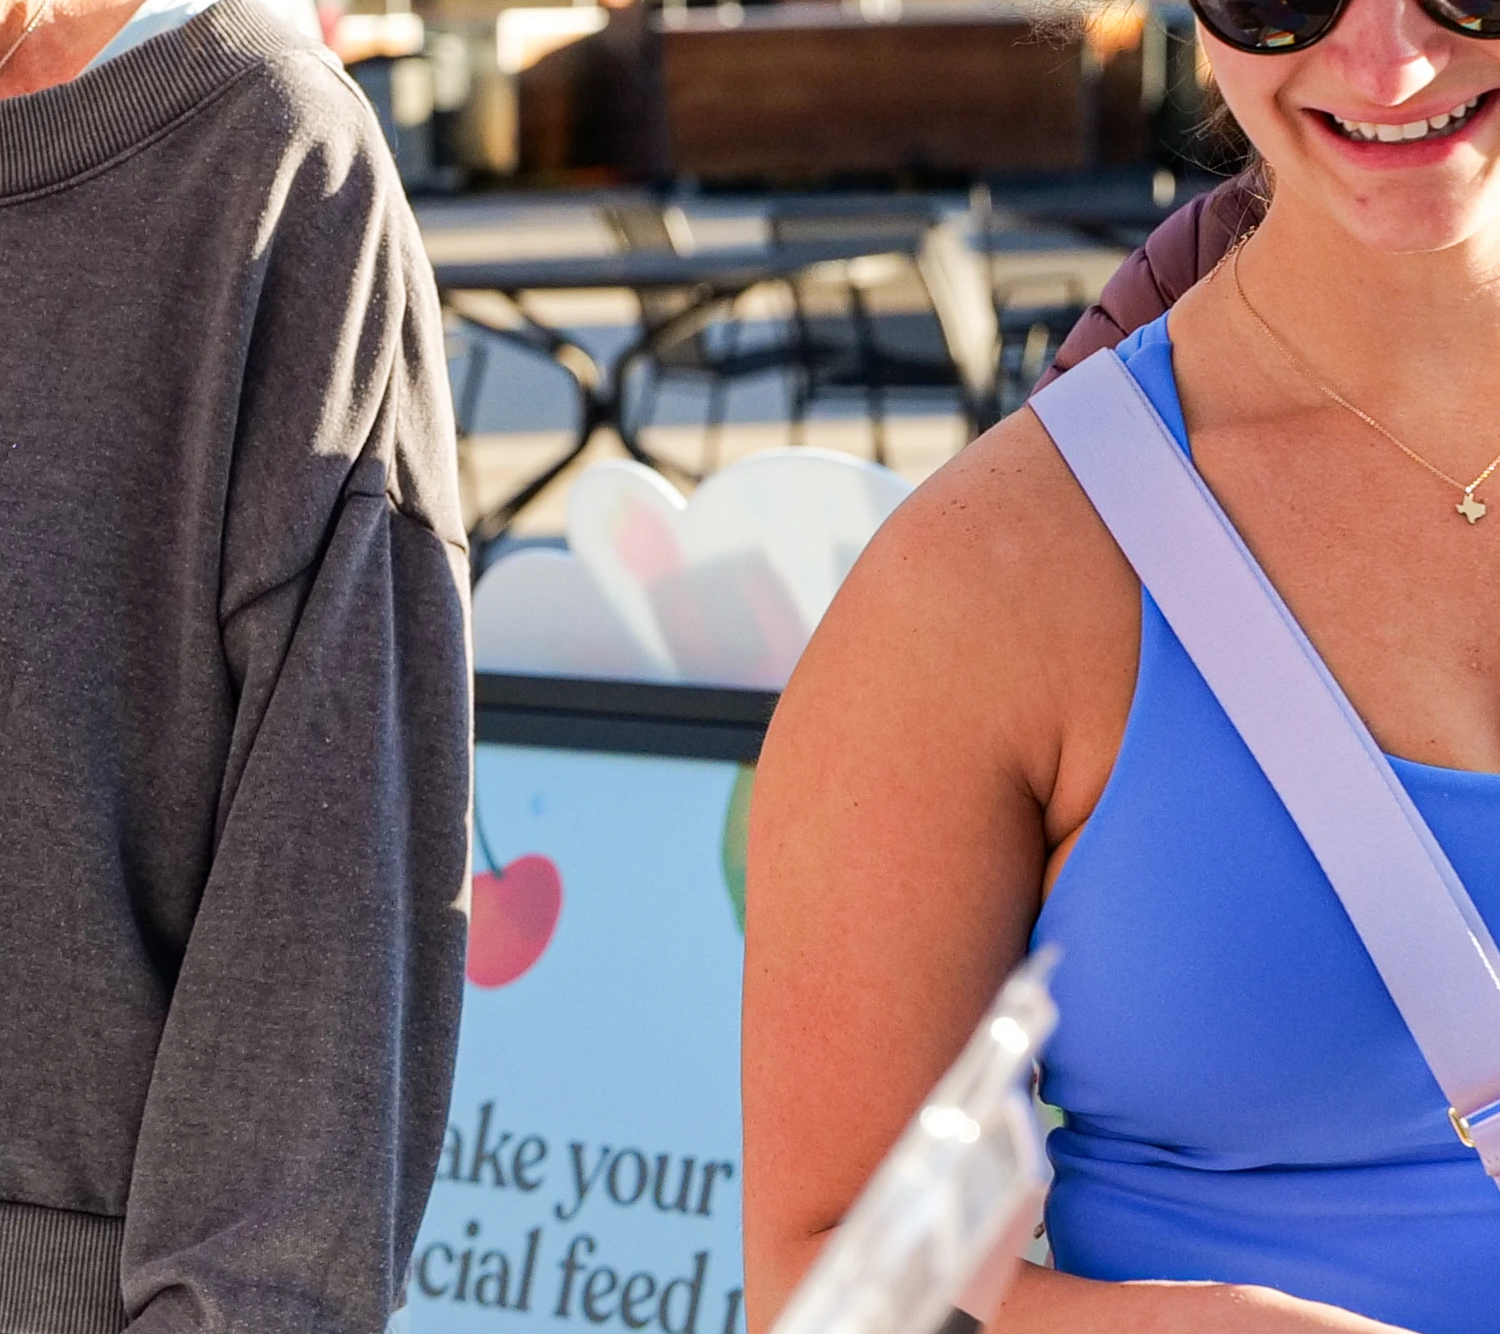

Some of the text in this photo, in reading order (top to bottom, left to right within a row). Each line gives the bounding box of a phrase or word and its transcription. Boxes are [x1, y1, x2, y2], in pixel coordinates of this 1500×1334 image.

[436, 1098, 735, 1222] ake your
[415, 1219, 543, 1314] cial
